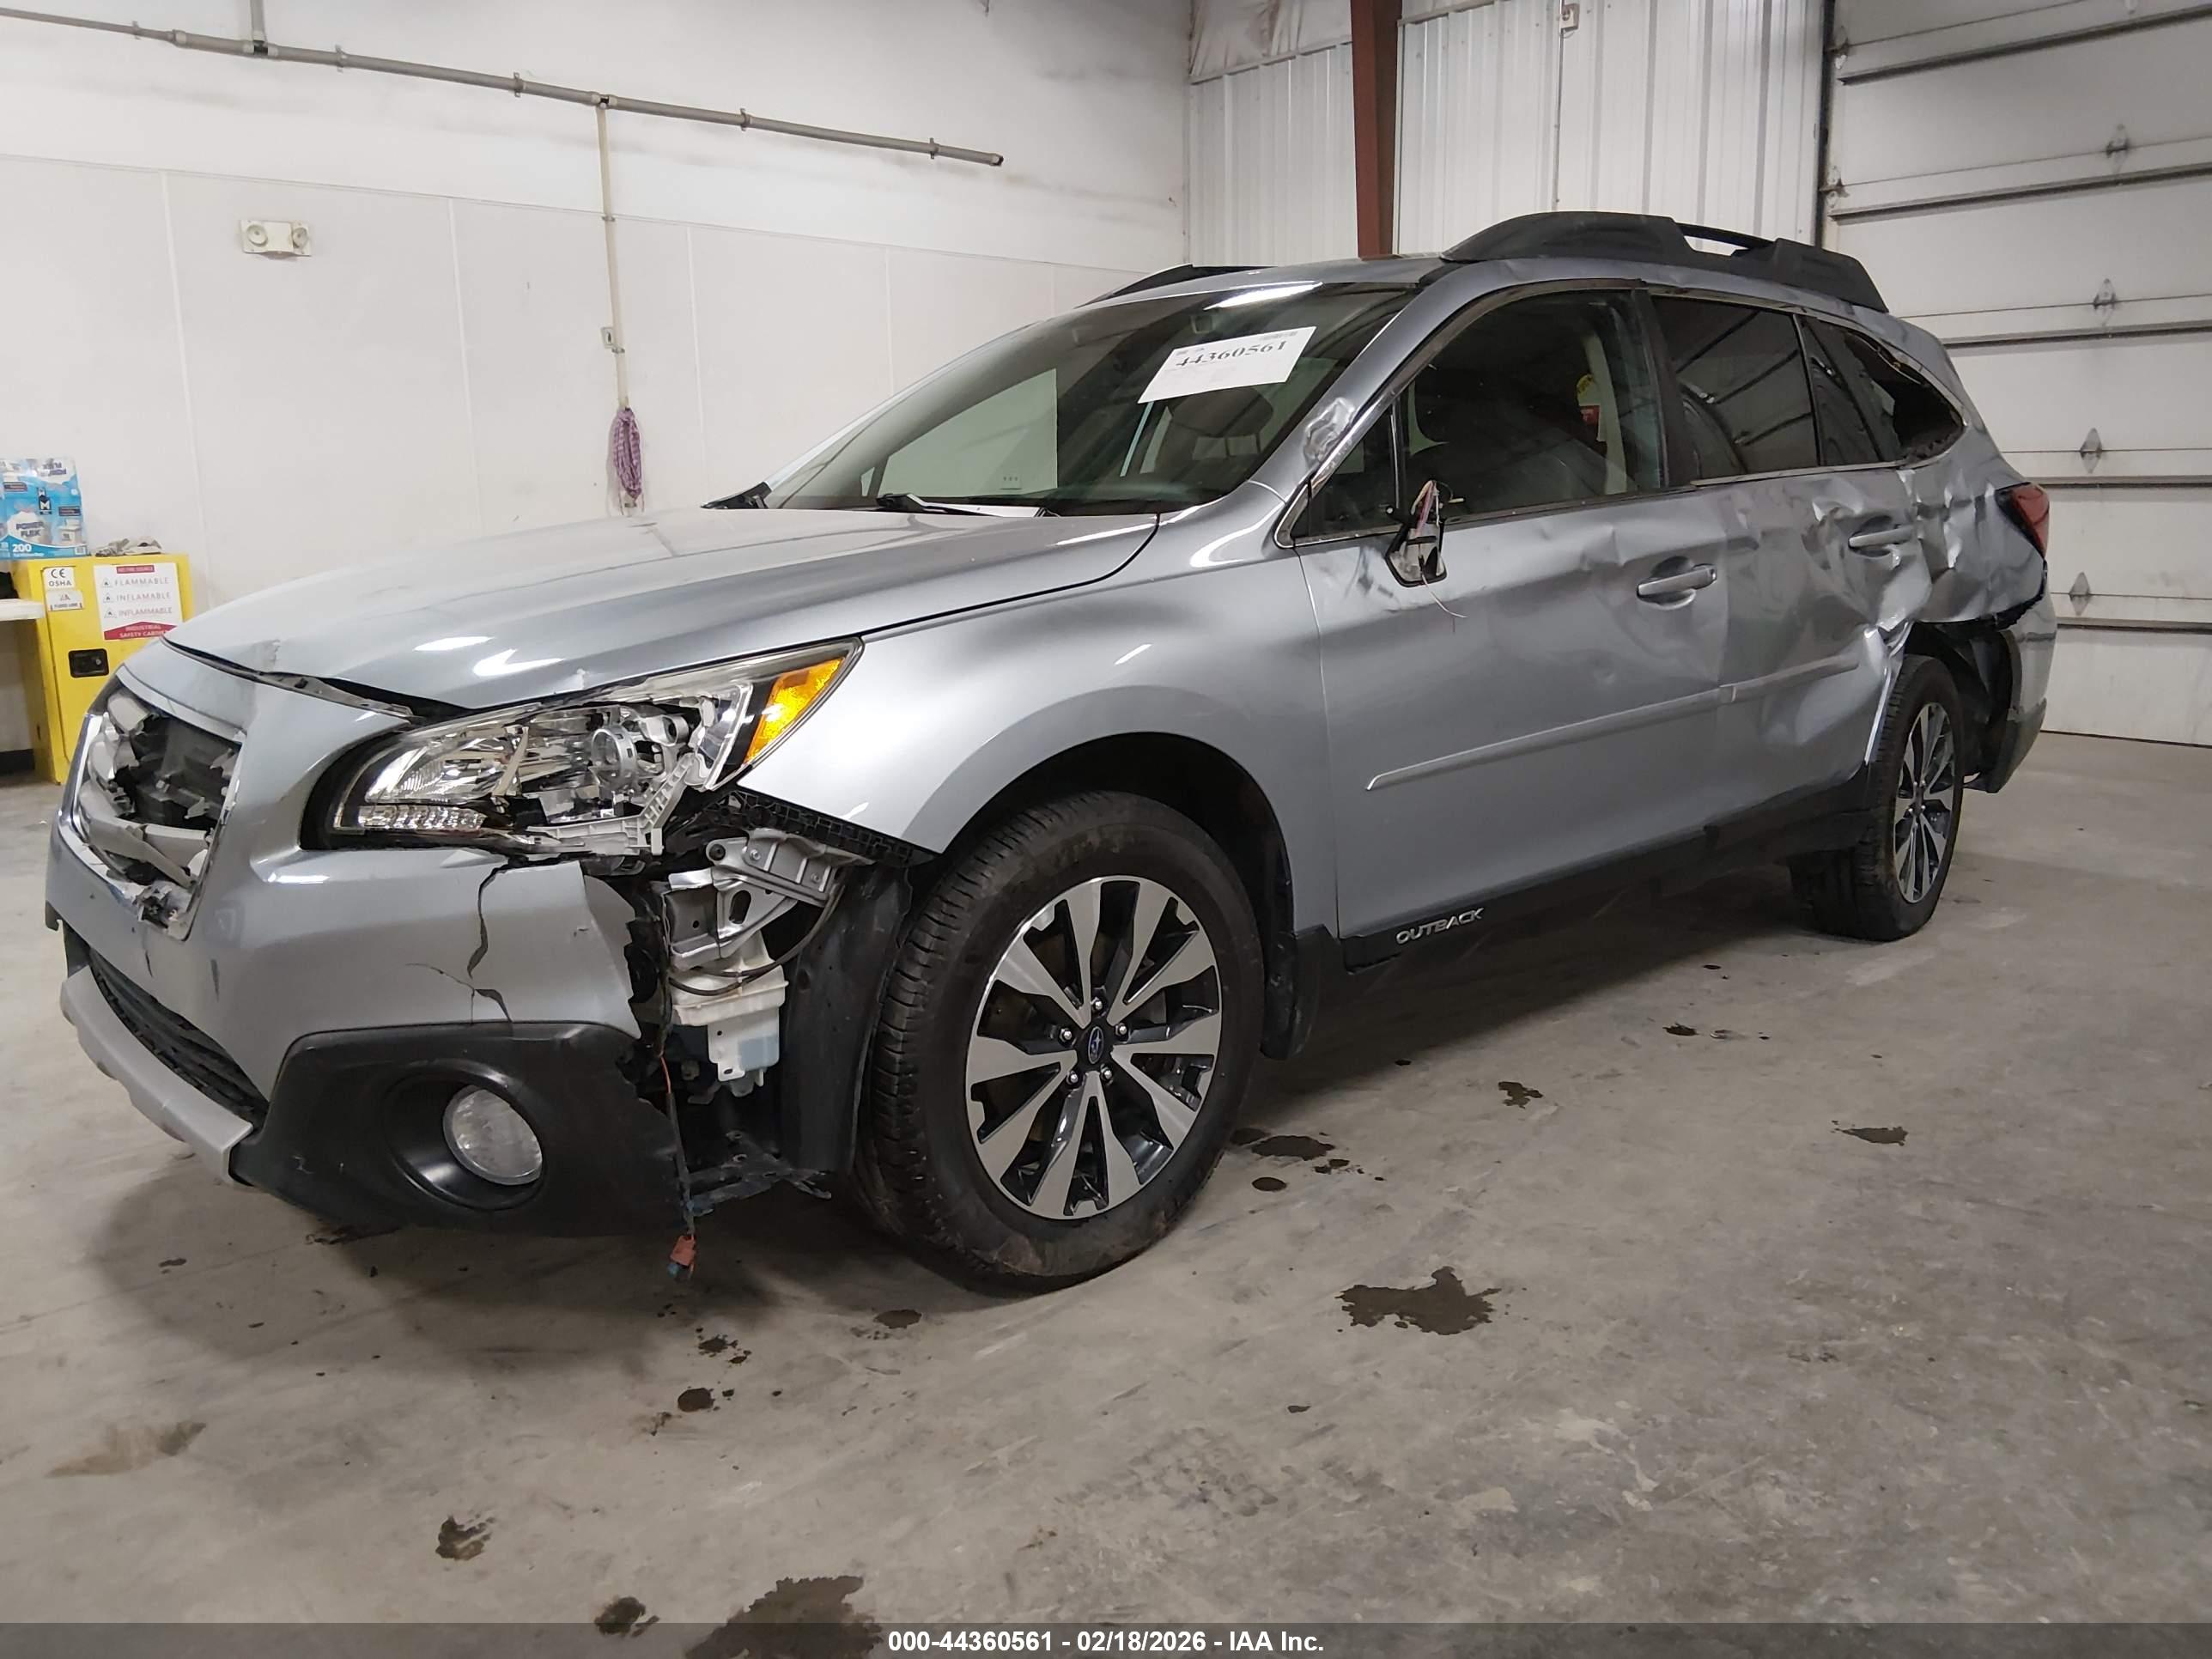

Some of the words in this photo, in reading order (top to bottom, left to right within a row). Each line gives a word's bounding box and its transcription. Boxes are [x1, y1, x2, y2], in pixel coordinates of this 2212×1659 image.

[1176, 340, 1287, 367] 44360561
[21, 529, 41, 538] FLEX
[12, 544, 32, 553] 200
[51, 568, 65, 579] CE
[114, 577, 170, 586] FLAMMABLE
[116, 592, 171, 602] INFLAMABLE
[118, 606, 173, 617] INFLAMMABLE
[1395, 908, 1485, 945] OUTBACK
